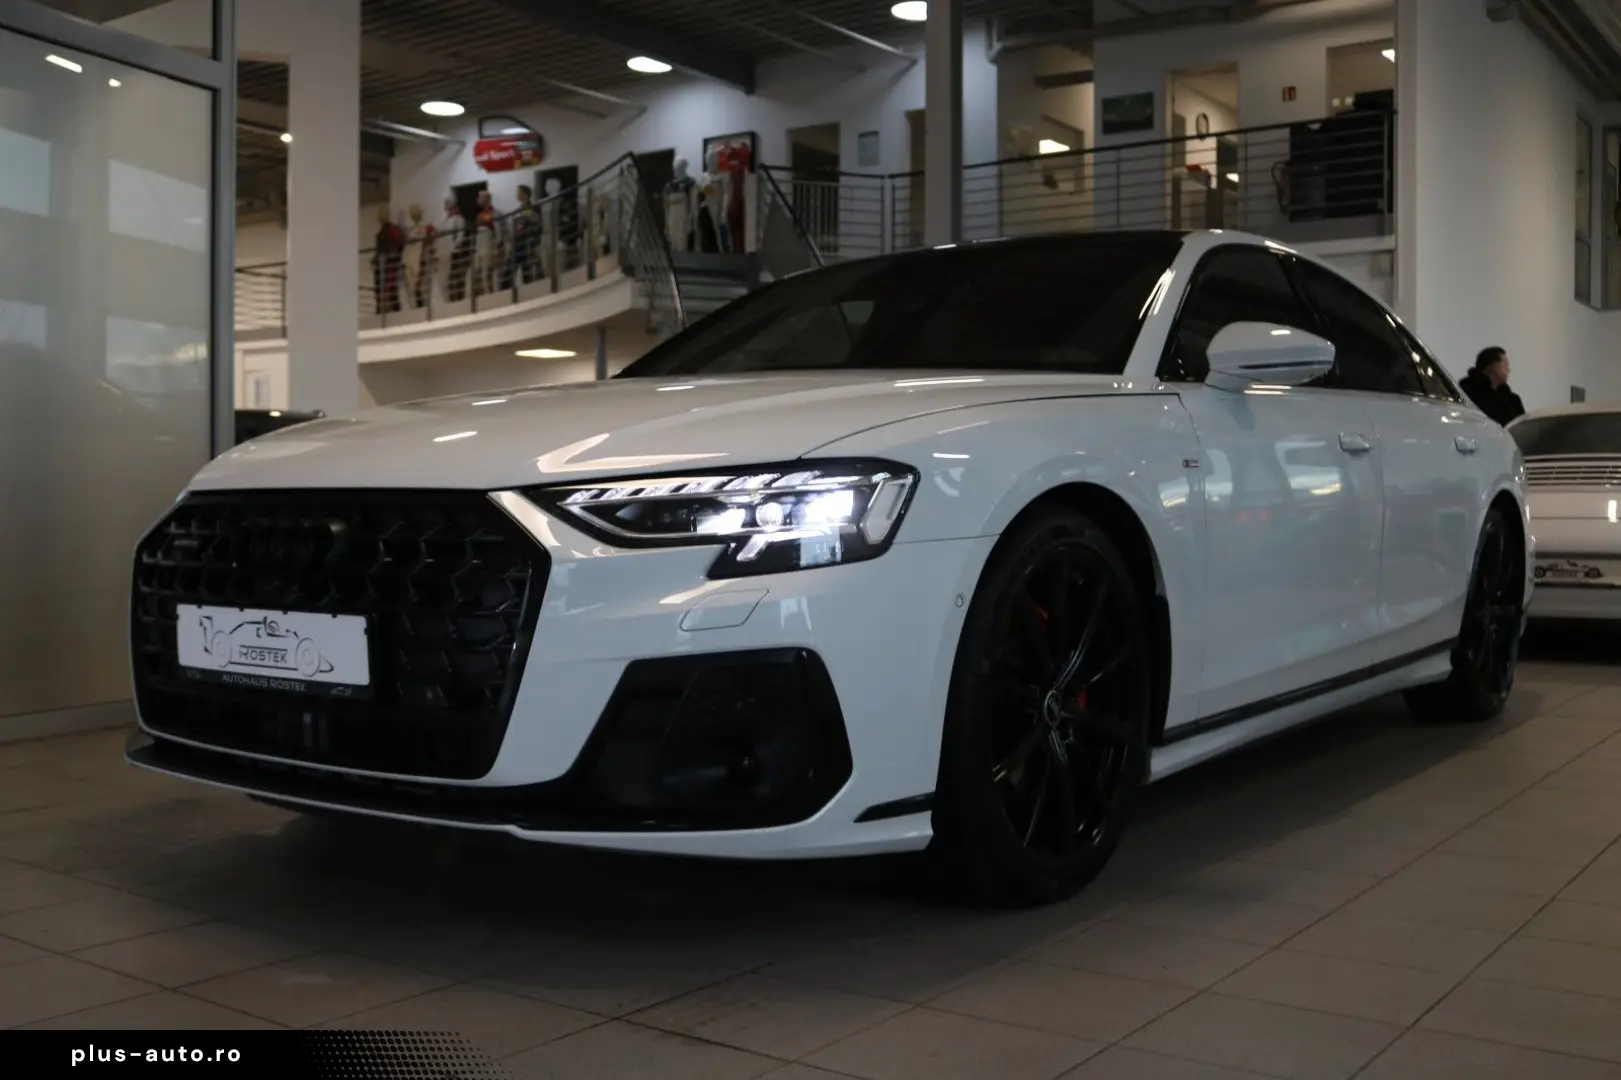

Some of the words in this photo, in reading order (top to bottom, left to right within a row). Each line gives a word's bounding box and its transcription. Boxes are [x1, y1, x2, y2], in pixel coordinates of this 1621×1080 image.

[238, 647, 288, 664] ROSTEK
[222, 673, 268, 688] AUTOHAUS
[269, 679, 307, 692] ROSTEK
